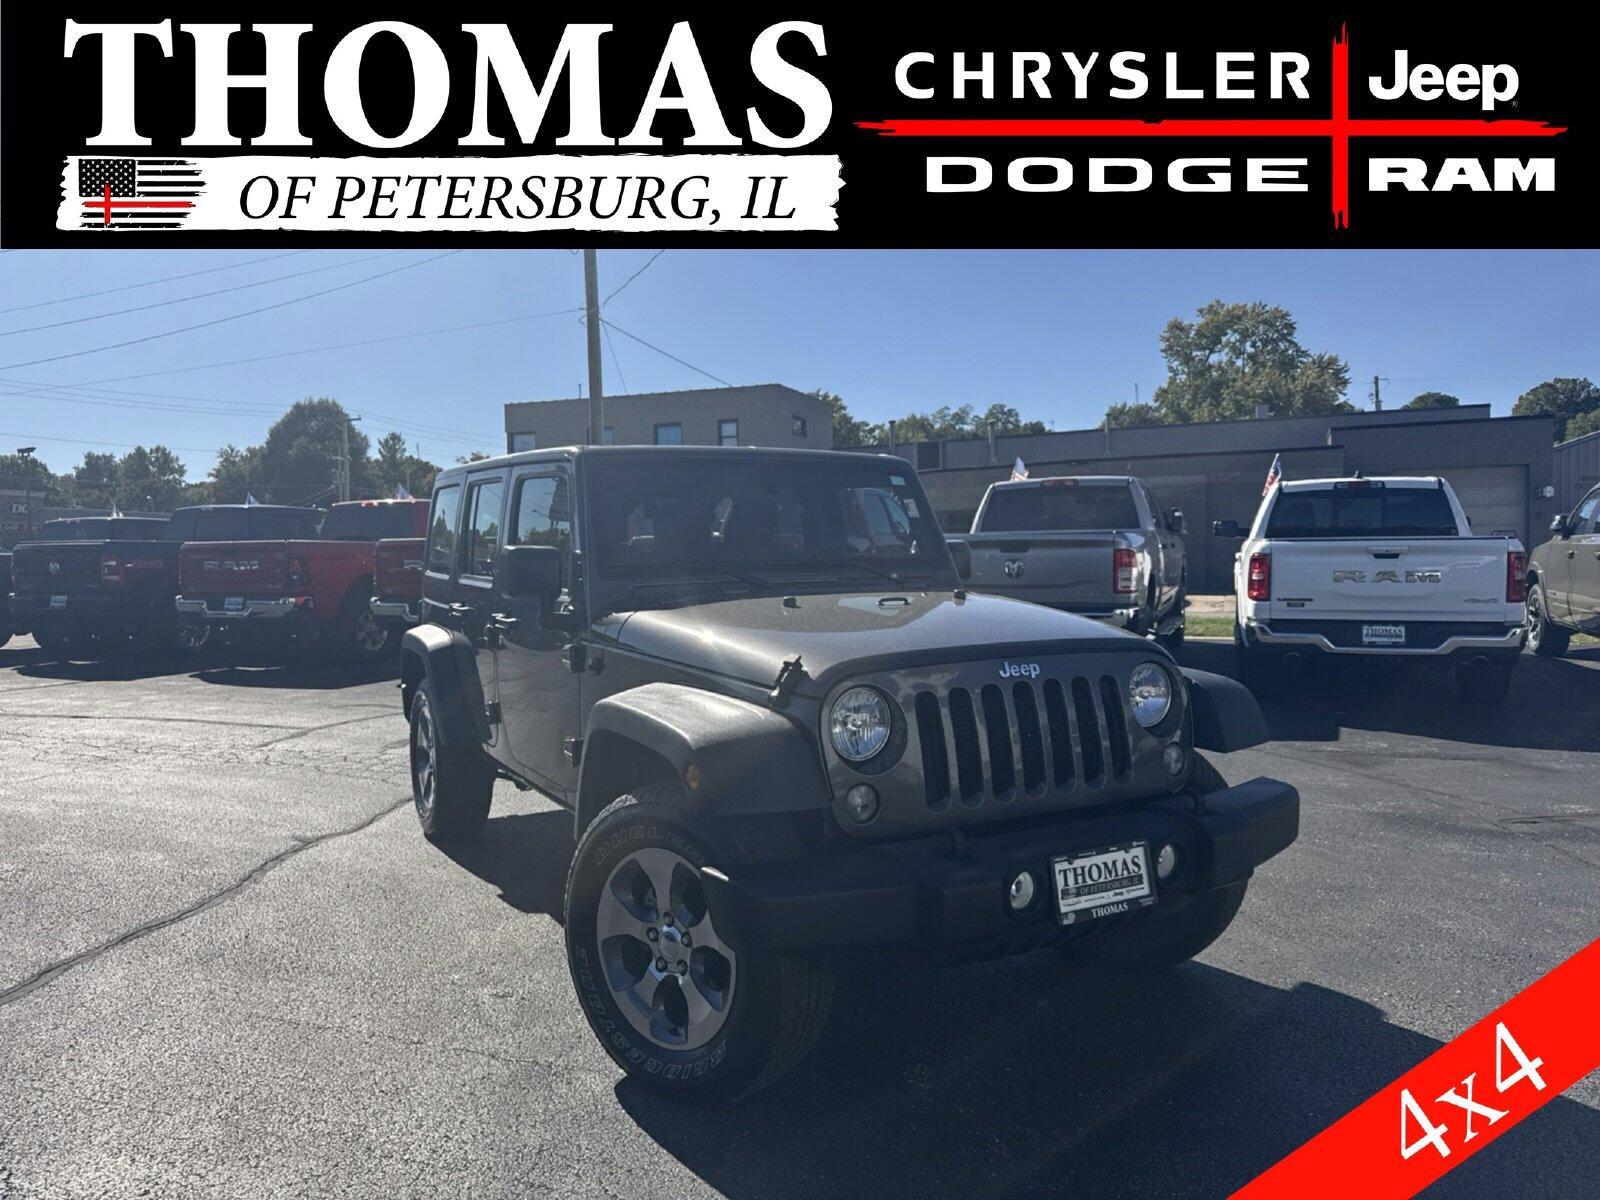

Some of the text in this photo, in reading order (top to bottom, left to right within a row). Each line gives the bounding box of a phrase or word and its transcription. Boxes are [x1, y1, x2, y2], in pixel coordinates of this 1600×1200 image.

[1332, 570, 1442, 583] RAM
[1364, 626, 1403, 636] THOMAS
[999, 661, 1040, 678] Jeep
[595, 825, 704, 866] DUELER
[1058, 855, 1142, 888] THOMAS
[1091, 901, 1129, 918] THOMAS
[574, 943, 728, 1079] BRIDGESTONE
